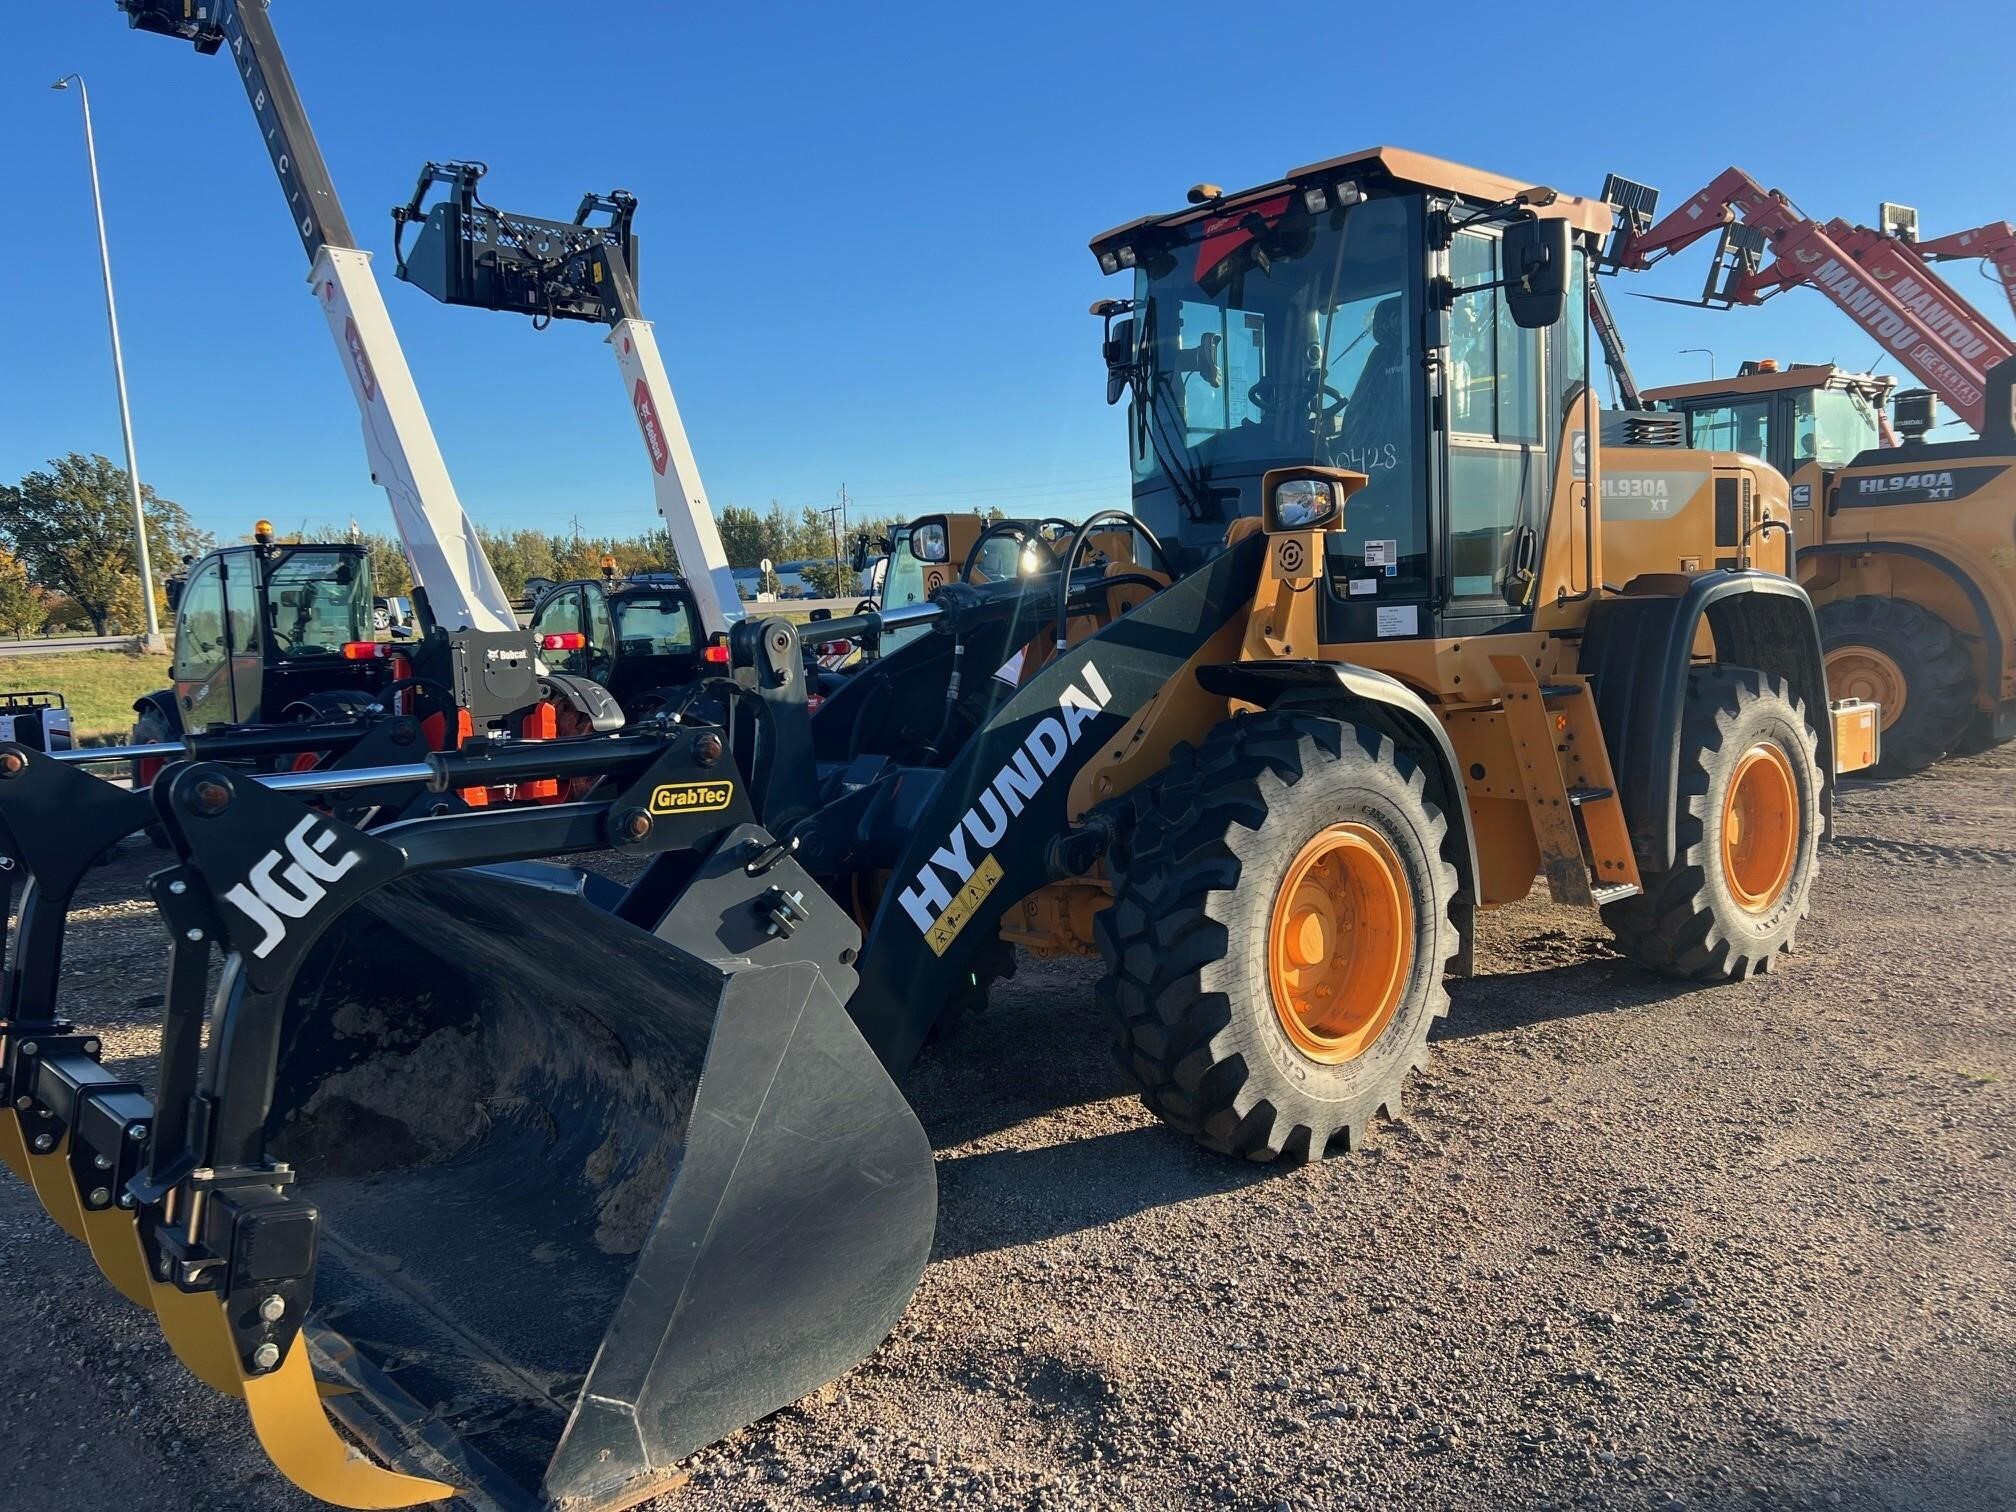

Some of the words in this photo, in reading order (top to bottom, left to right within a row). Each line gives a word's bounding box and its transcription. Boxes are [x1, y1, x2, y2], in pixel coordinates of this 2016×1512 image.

[1813, 258, 1921, 350] MANITOU
[1890, 276, 1989, 360] MANITOU
[1914, 348, 1940, 369] JGE
[645, 420, 663, 461] Bobcat
[1859, 472, 1953, 494] HL940A
[1928, 487, 1953, 499] XT
[1650, 499, 1669, 512] XT
[499, 649, 528, 660] Bobcat
[657, 787, 726, 807] GrabTec
[897, 660, 1112, 935] HYUNDAI
[225, 813, 359, 960] JGE
